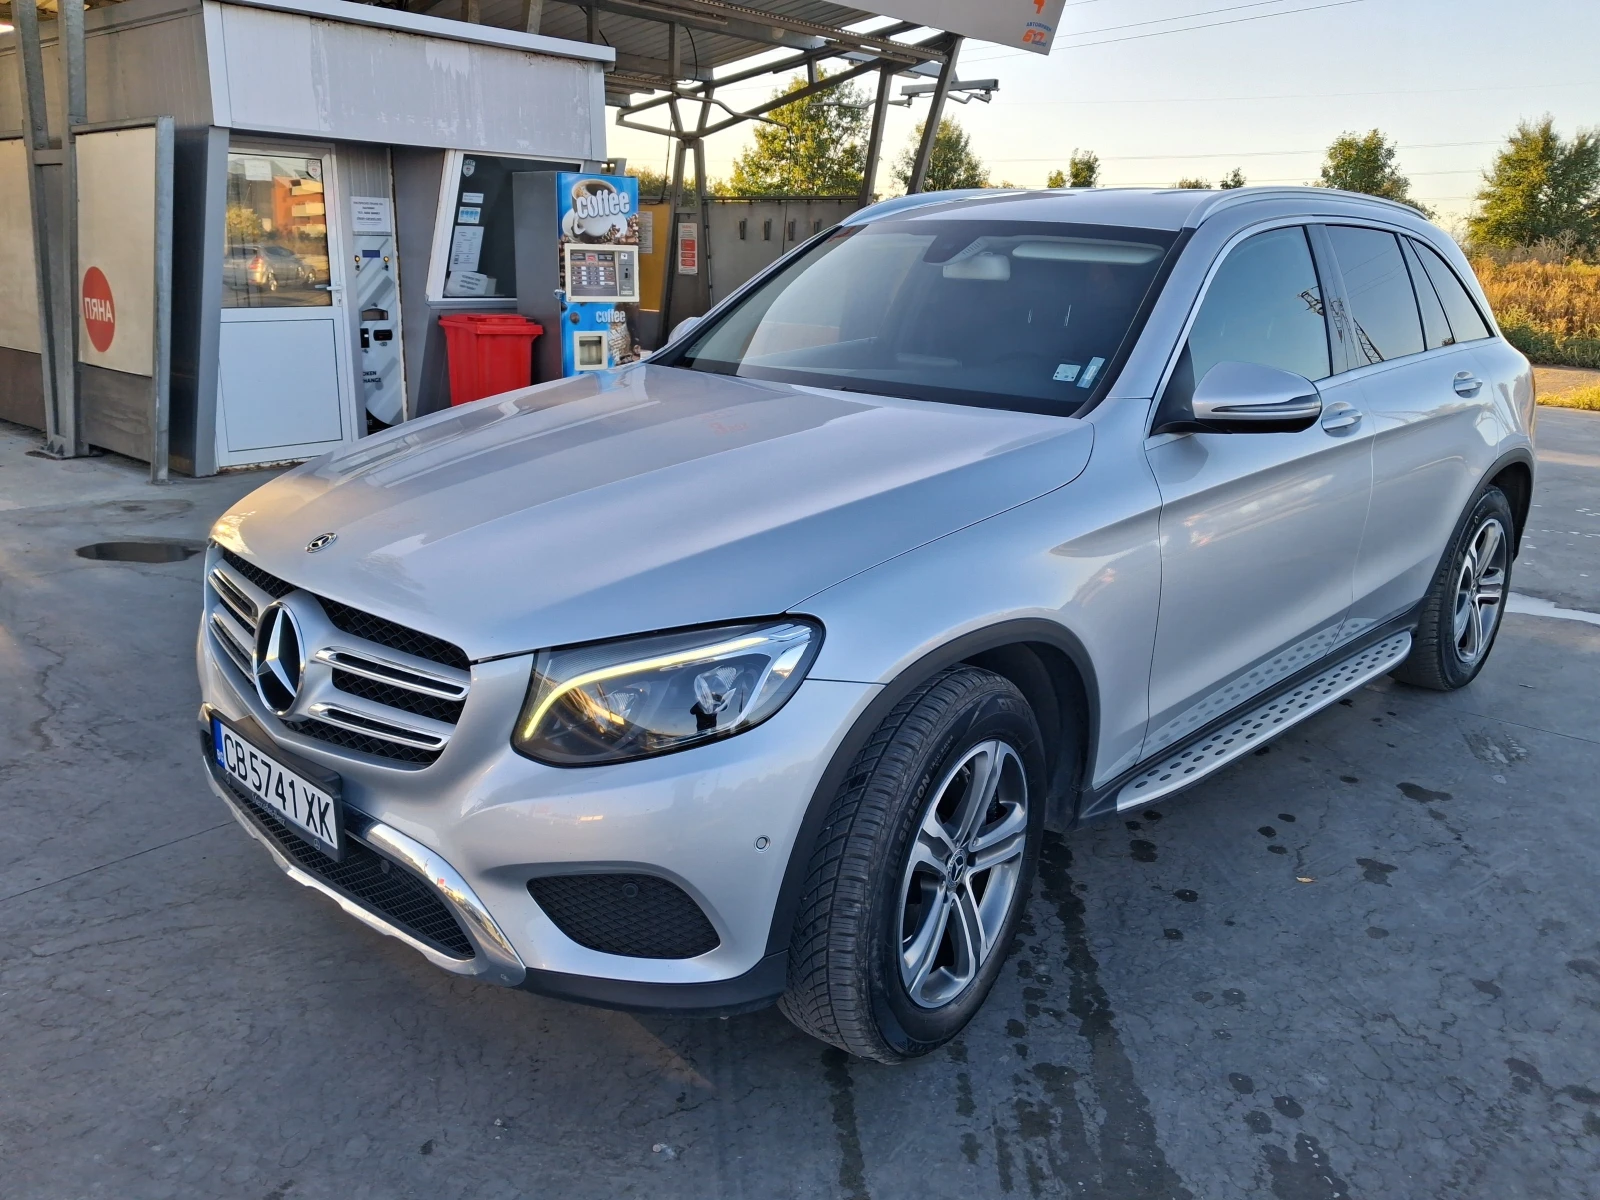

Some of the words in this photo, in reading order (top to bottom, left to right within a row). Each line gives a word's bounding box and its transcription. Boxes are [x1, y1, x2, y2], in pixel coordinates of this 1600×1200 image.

[576, 189, 630, 219] coffee
[84, 297, 114, 323] ПЯНА
[596, 308, 626, 323] coffee
[898, 773, 931, 843] SEASON
